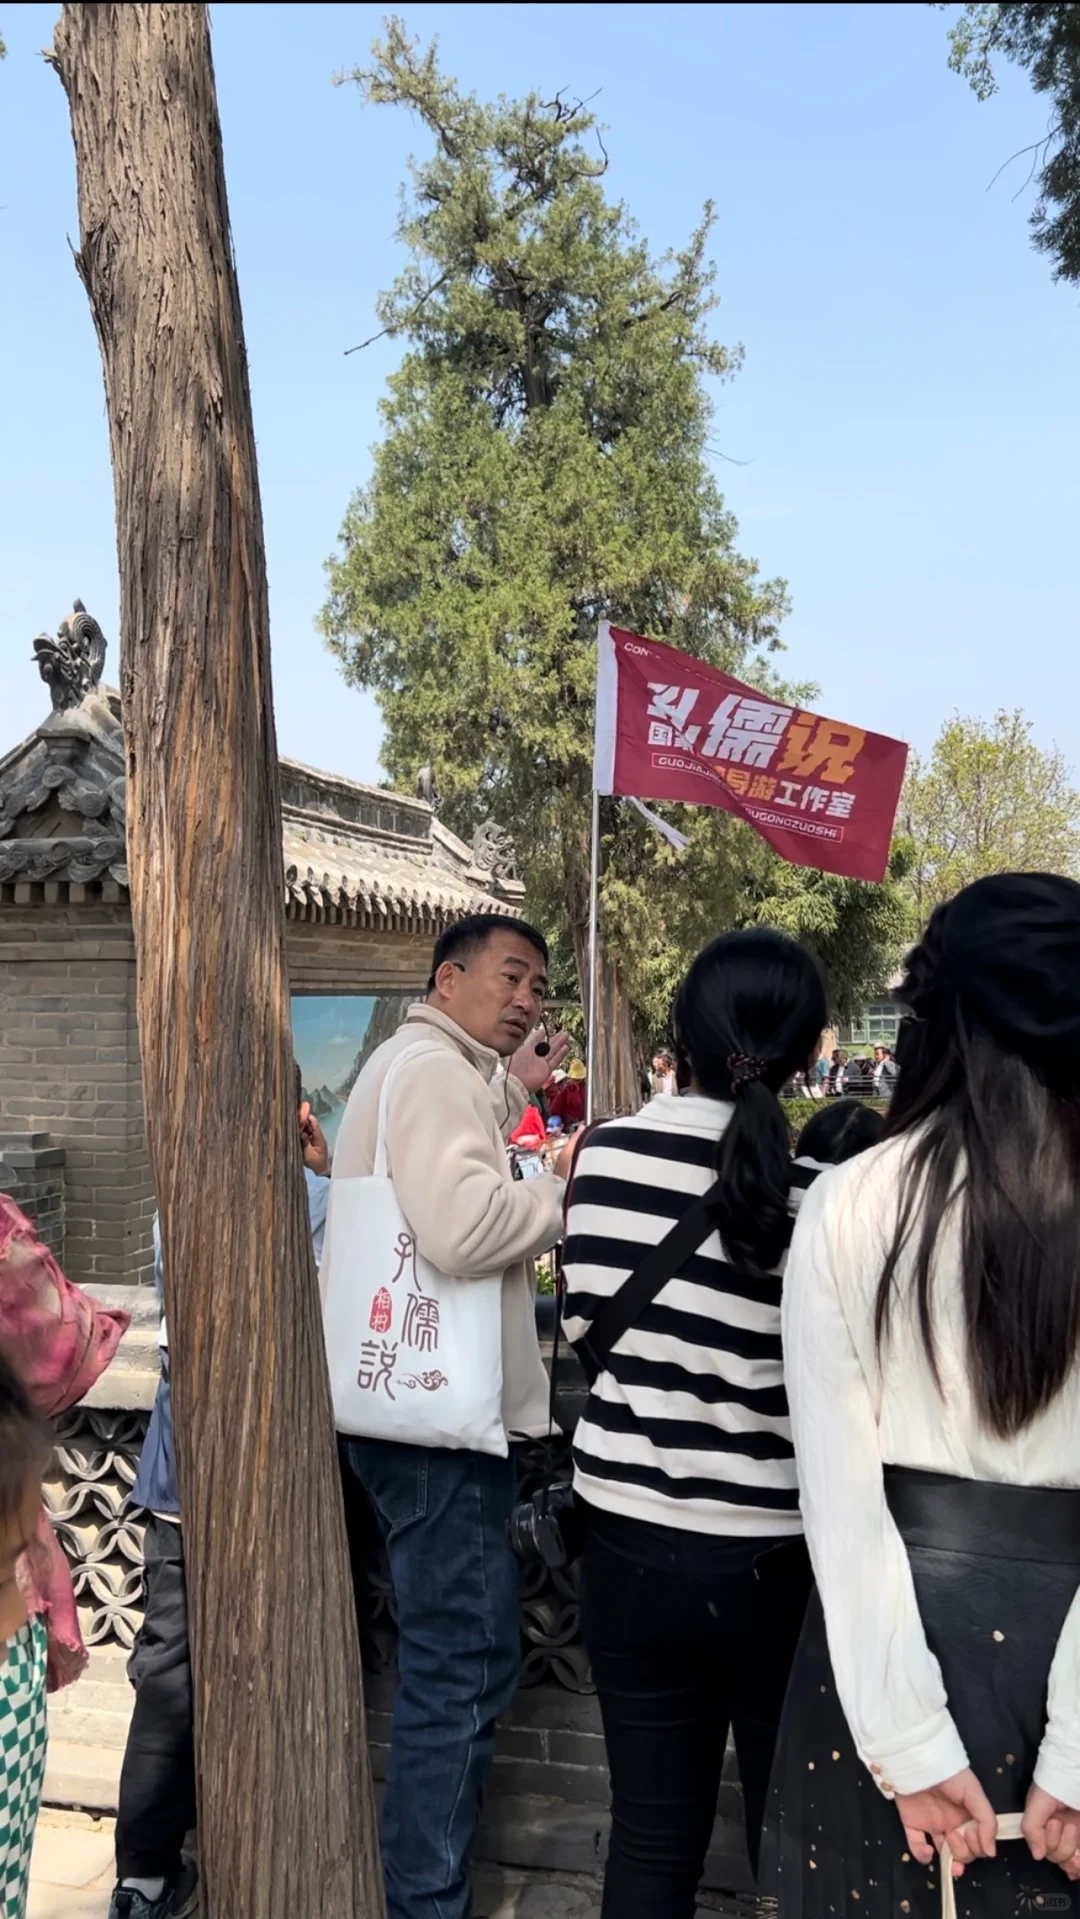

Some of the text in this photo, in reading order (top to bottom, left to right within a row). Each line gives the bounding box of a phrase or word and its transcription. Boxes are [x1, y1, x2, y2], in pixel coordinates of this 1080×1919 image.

[623, 641, 650, 657] CON
[713, 765, 857, 819] 导游工作室
